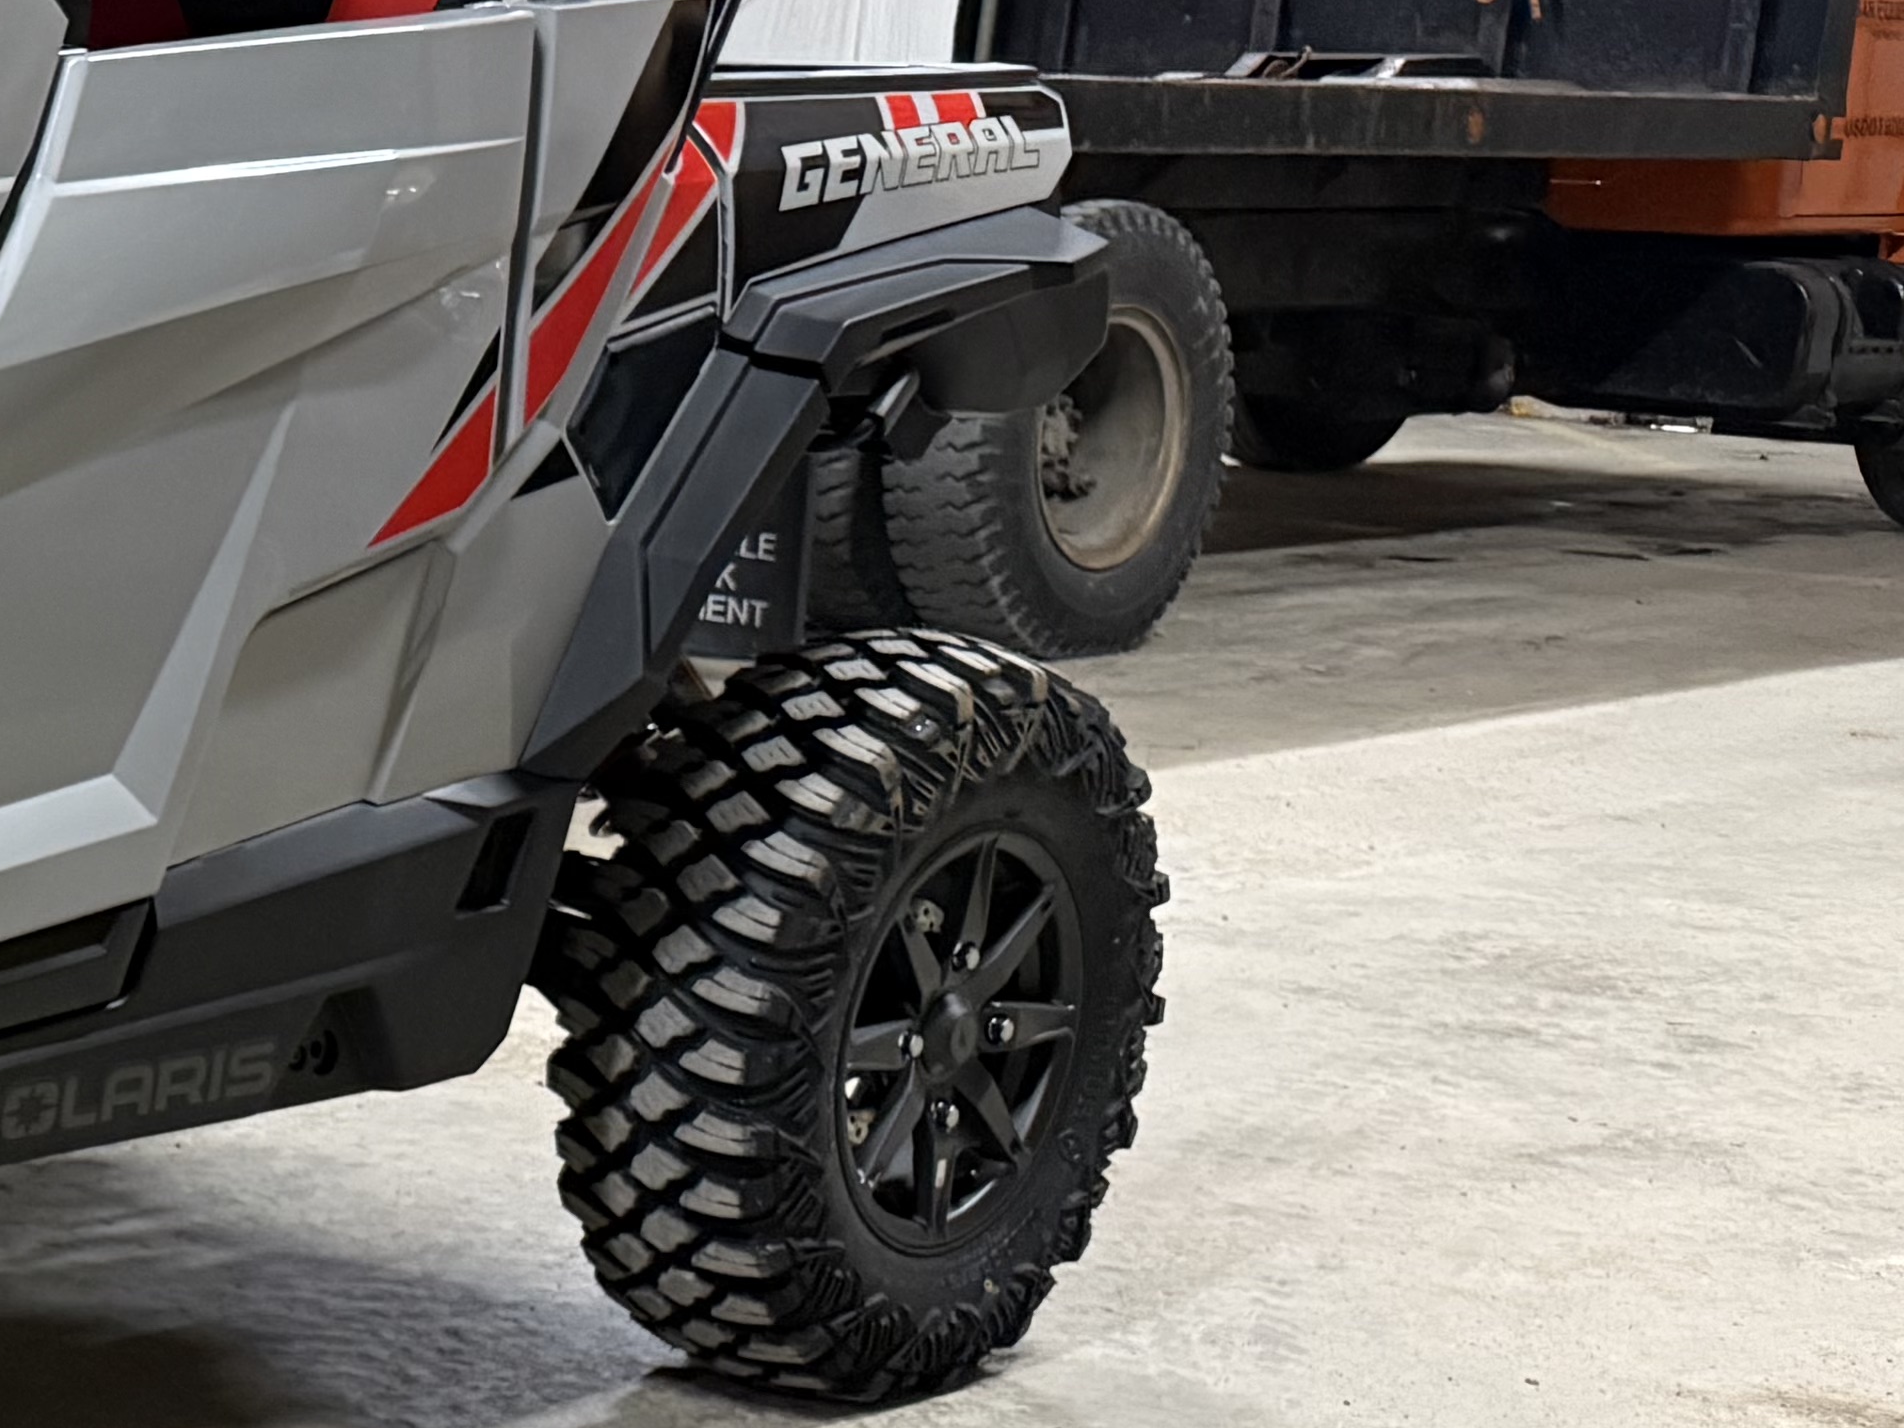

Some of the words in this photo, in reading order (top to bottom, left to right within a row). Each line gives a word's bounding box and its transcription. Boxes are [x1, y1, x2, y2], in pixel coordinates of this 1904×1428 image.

[779, 115, 1041, 212] GENERAL
[735, 532, 777, 563] LE
[698, 593, 769, 628] ENT
